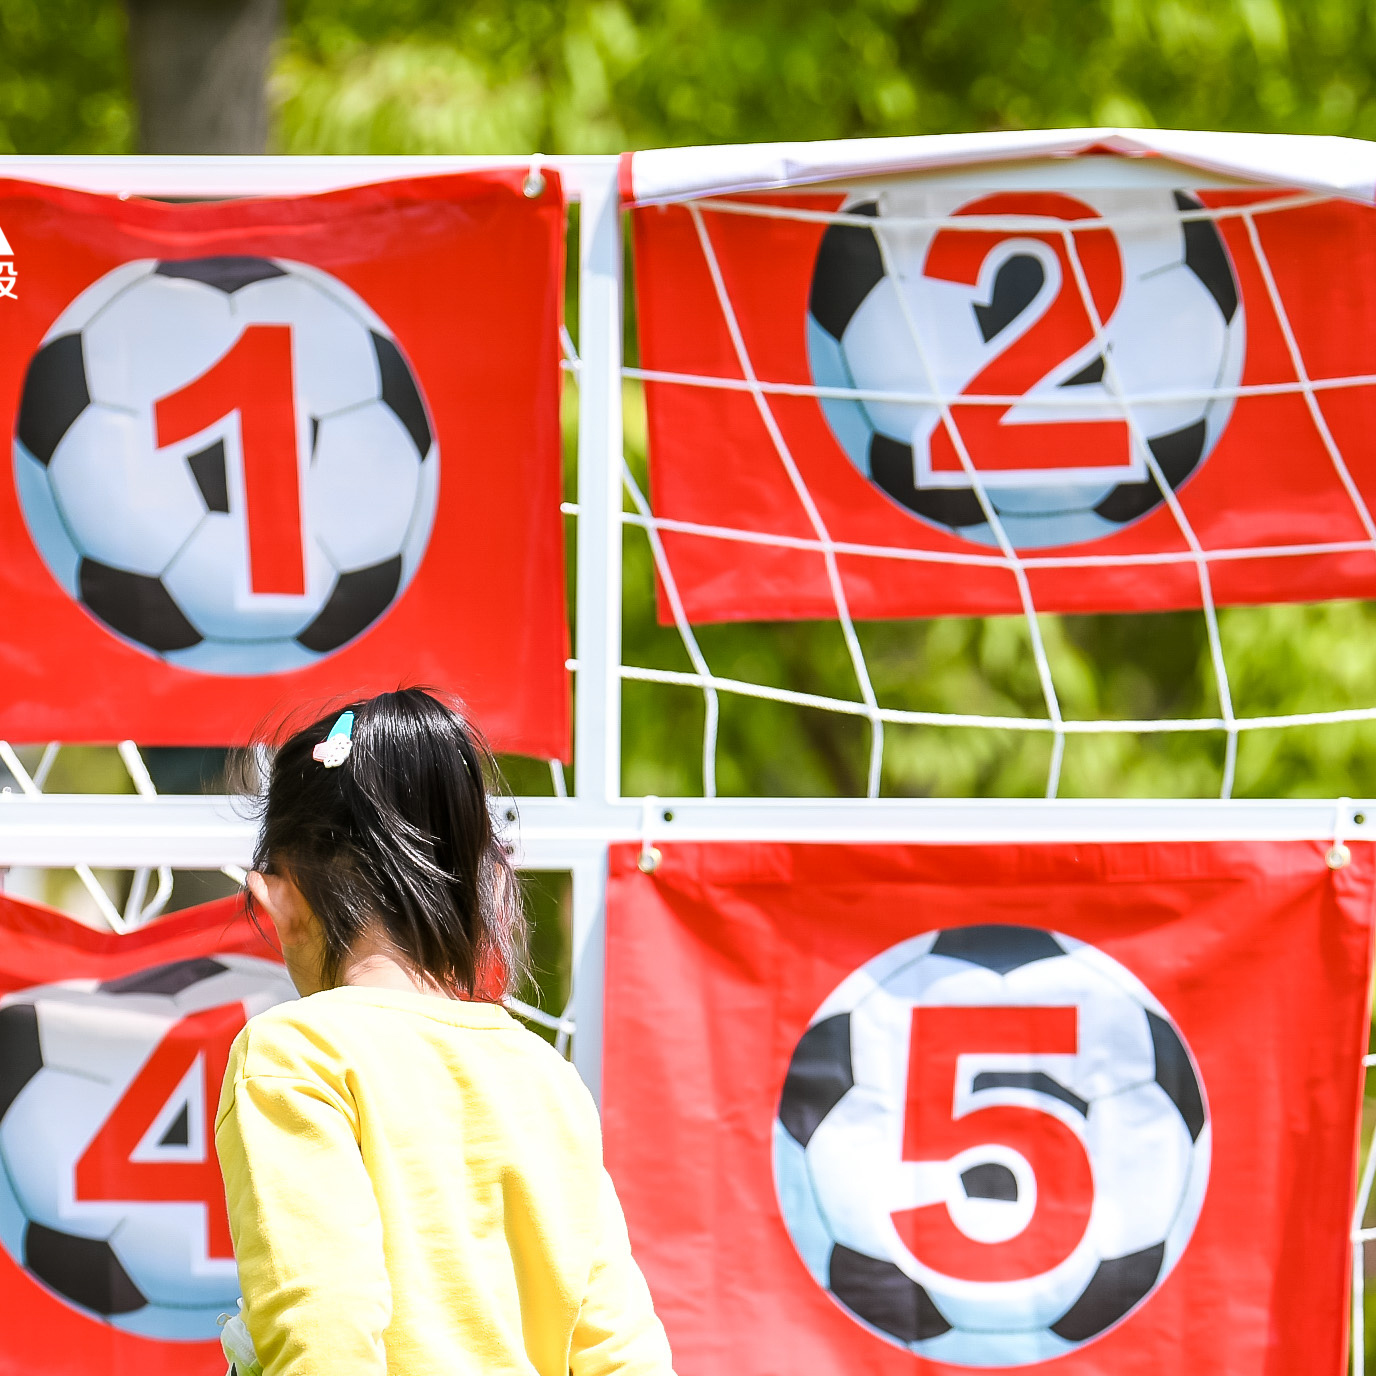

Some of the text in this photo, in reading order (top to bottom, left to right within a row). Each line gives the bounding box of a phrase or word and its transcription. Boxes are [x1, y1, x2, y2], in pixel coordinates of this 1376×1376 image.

[155, 324, 306, 597] 1
[922, 188, 1132, 473] 2
[75, 1000, 247, 1260] 4
[889, 1005, 1095, 1283] 5
